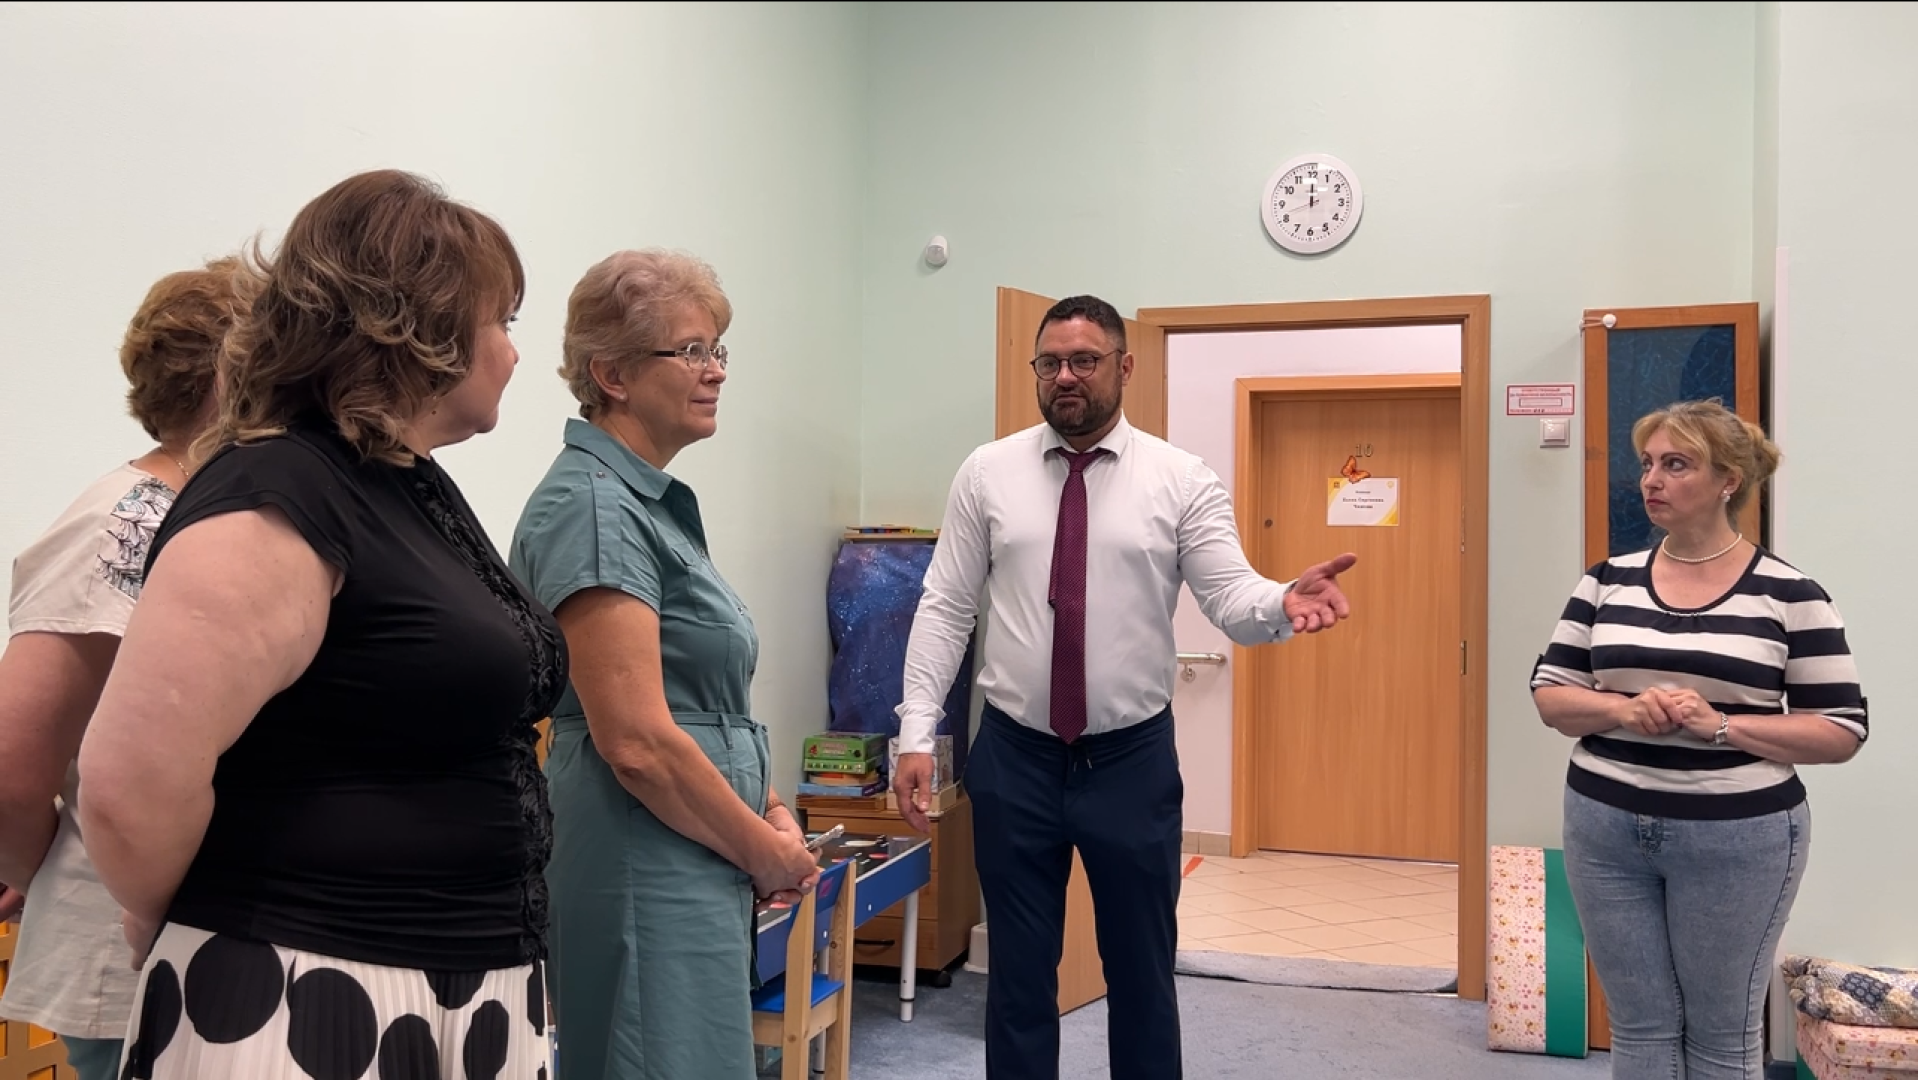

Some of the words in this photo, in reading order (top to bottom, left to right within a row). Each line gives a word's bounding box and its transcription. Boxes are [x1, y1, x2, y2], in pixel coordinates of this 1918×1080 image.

[1294, 175, 1302, 184] 11
[1307, 171, 1318, 179] 12
[1284, 186, 1294, 194] 10
[1334, 184, 1341, 193] 2
[1278, 200, 1286, 209] 9
[1338, 198, 1345, 207] 3
[1282, 214, 1290, 223] 8
[1332, 213, 1339, 221] 4
[1293, 223, 1301, 232] 7
[1306, 227, 1314, 236] 6
[1321, 222, 1329, 232] 5
[1355, 443, 1374, 458] 10
